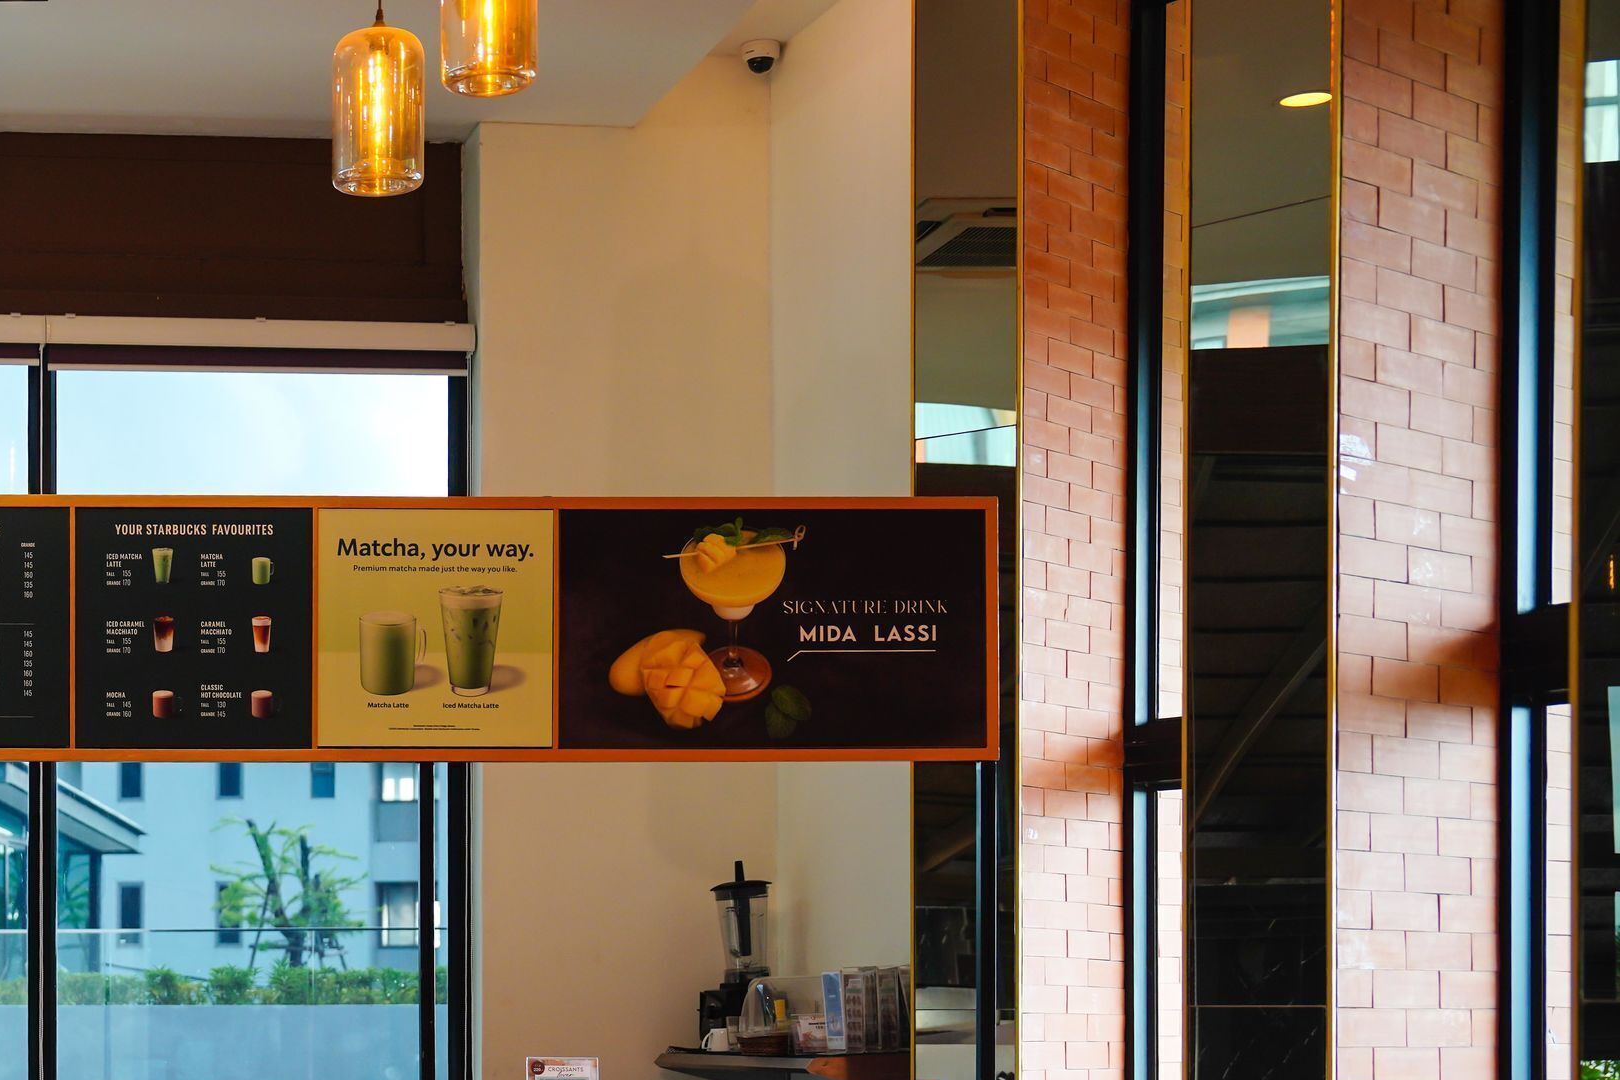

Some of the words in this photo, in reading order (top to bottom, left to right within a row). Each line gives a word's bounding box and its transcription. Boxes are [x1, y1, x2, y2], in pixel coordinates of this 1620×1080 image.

[115, 525, 143, 535] YOUR
[146, 525, 207, 535] STARBUCKS
[212, 525, 274, 535] FAVOURITES
[337, 538, 426, 561] Matcha,
[432, 543, 480, 561] your
[486, 543, 534, 561] way.
[441, 565, 455, 573] just
[456, 565, 469, 573] the
[502, 565, 517, 573] like.
[24, 581, 33, 589] 135
[24, 591, 33, 599] 160
[783, 600, 887, 615] SIGNATURE
[894, 600, 948, 614] DRINK
[800, 625, 857, 643] MIDA
[874, 625, 937, 642] LASSI
[24, 640, 33, 648] 145
[24, 650, 33, 658] 160
